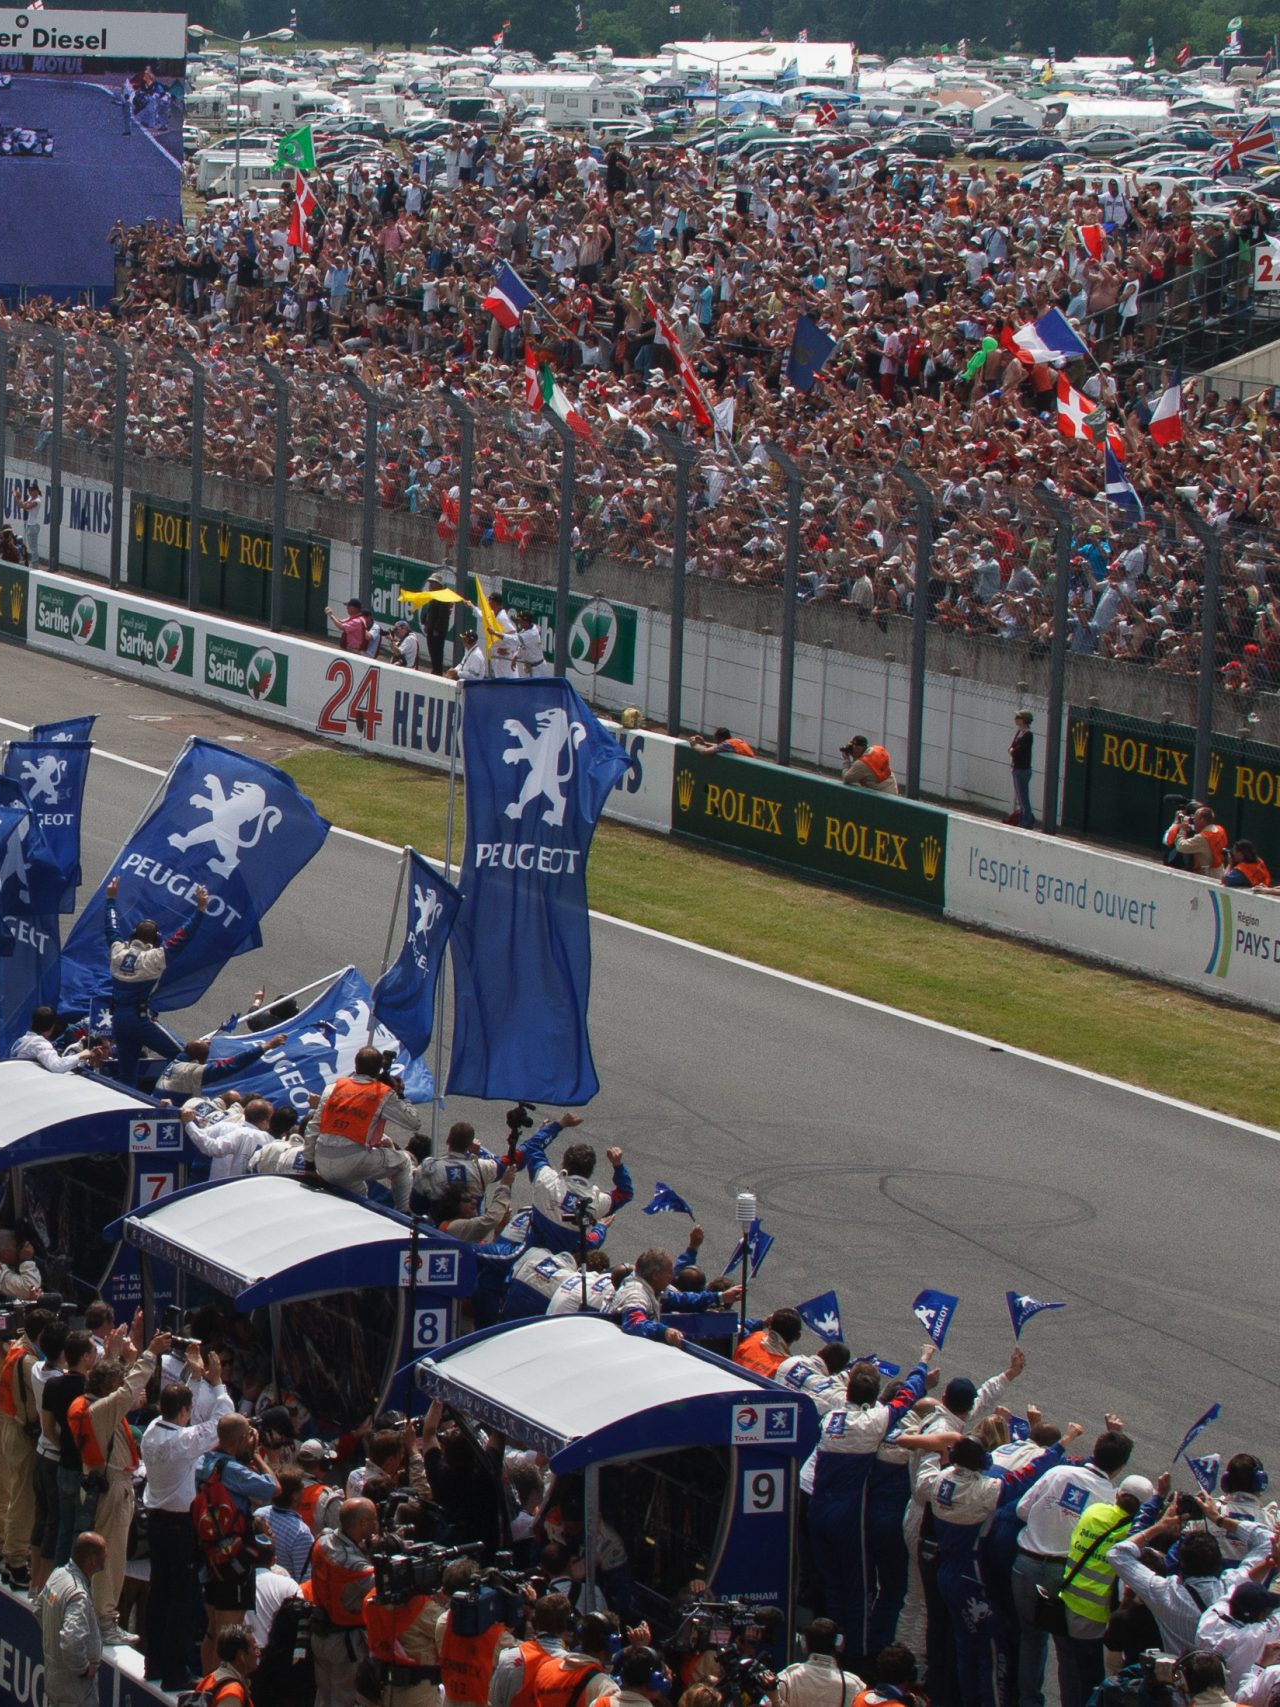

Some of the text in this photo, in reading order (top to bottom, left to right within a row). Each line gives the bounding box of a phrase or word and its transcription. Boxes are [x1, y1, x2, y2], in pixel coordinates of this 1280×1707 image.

[33, 28, 107, 50] Diesel
[32, 55, 83, 72] MOTUL
[70, 487, 112, 534] MANS
[239, 534, 301, 579] ROLX
[38, 603, 69, 633] Sarthe
[372, 582, 414, 622] arthe
[119, 627, 154, 659] Sarthe
[208, 653, 244, 687] Sarthe
[316, 657, 383, 742] 24
[1102, 733, 1189, 785] ROLEX
[704, 783, 908, 871] ROLEX ROLEX
[475, 842, 581, 875] PEUGEOT
[969, 846, 1157, 930] l'esprit grand ouvert
[1237, 911, 1260, 928] Région
[1235, 928, 1270, 960] PAYS
[146, 1176, 167, 1201] 7
[417, 1312, 439, 1345] 8
[752, 1472, 776, 1510] 9
